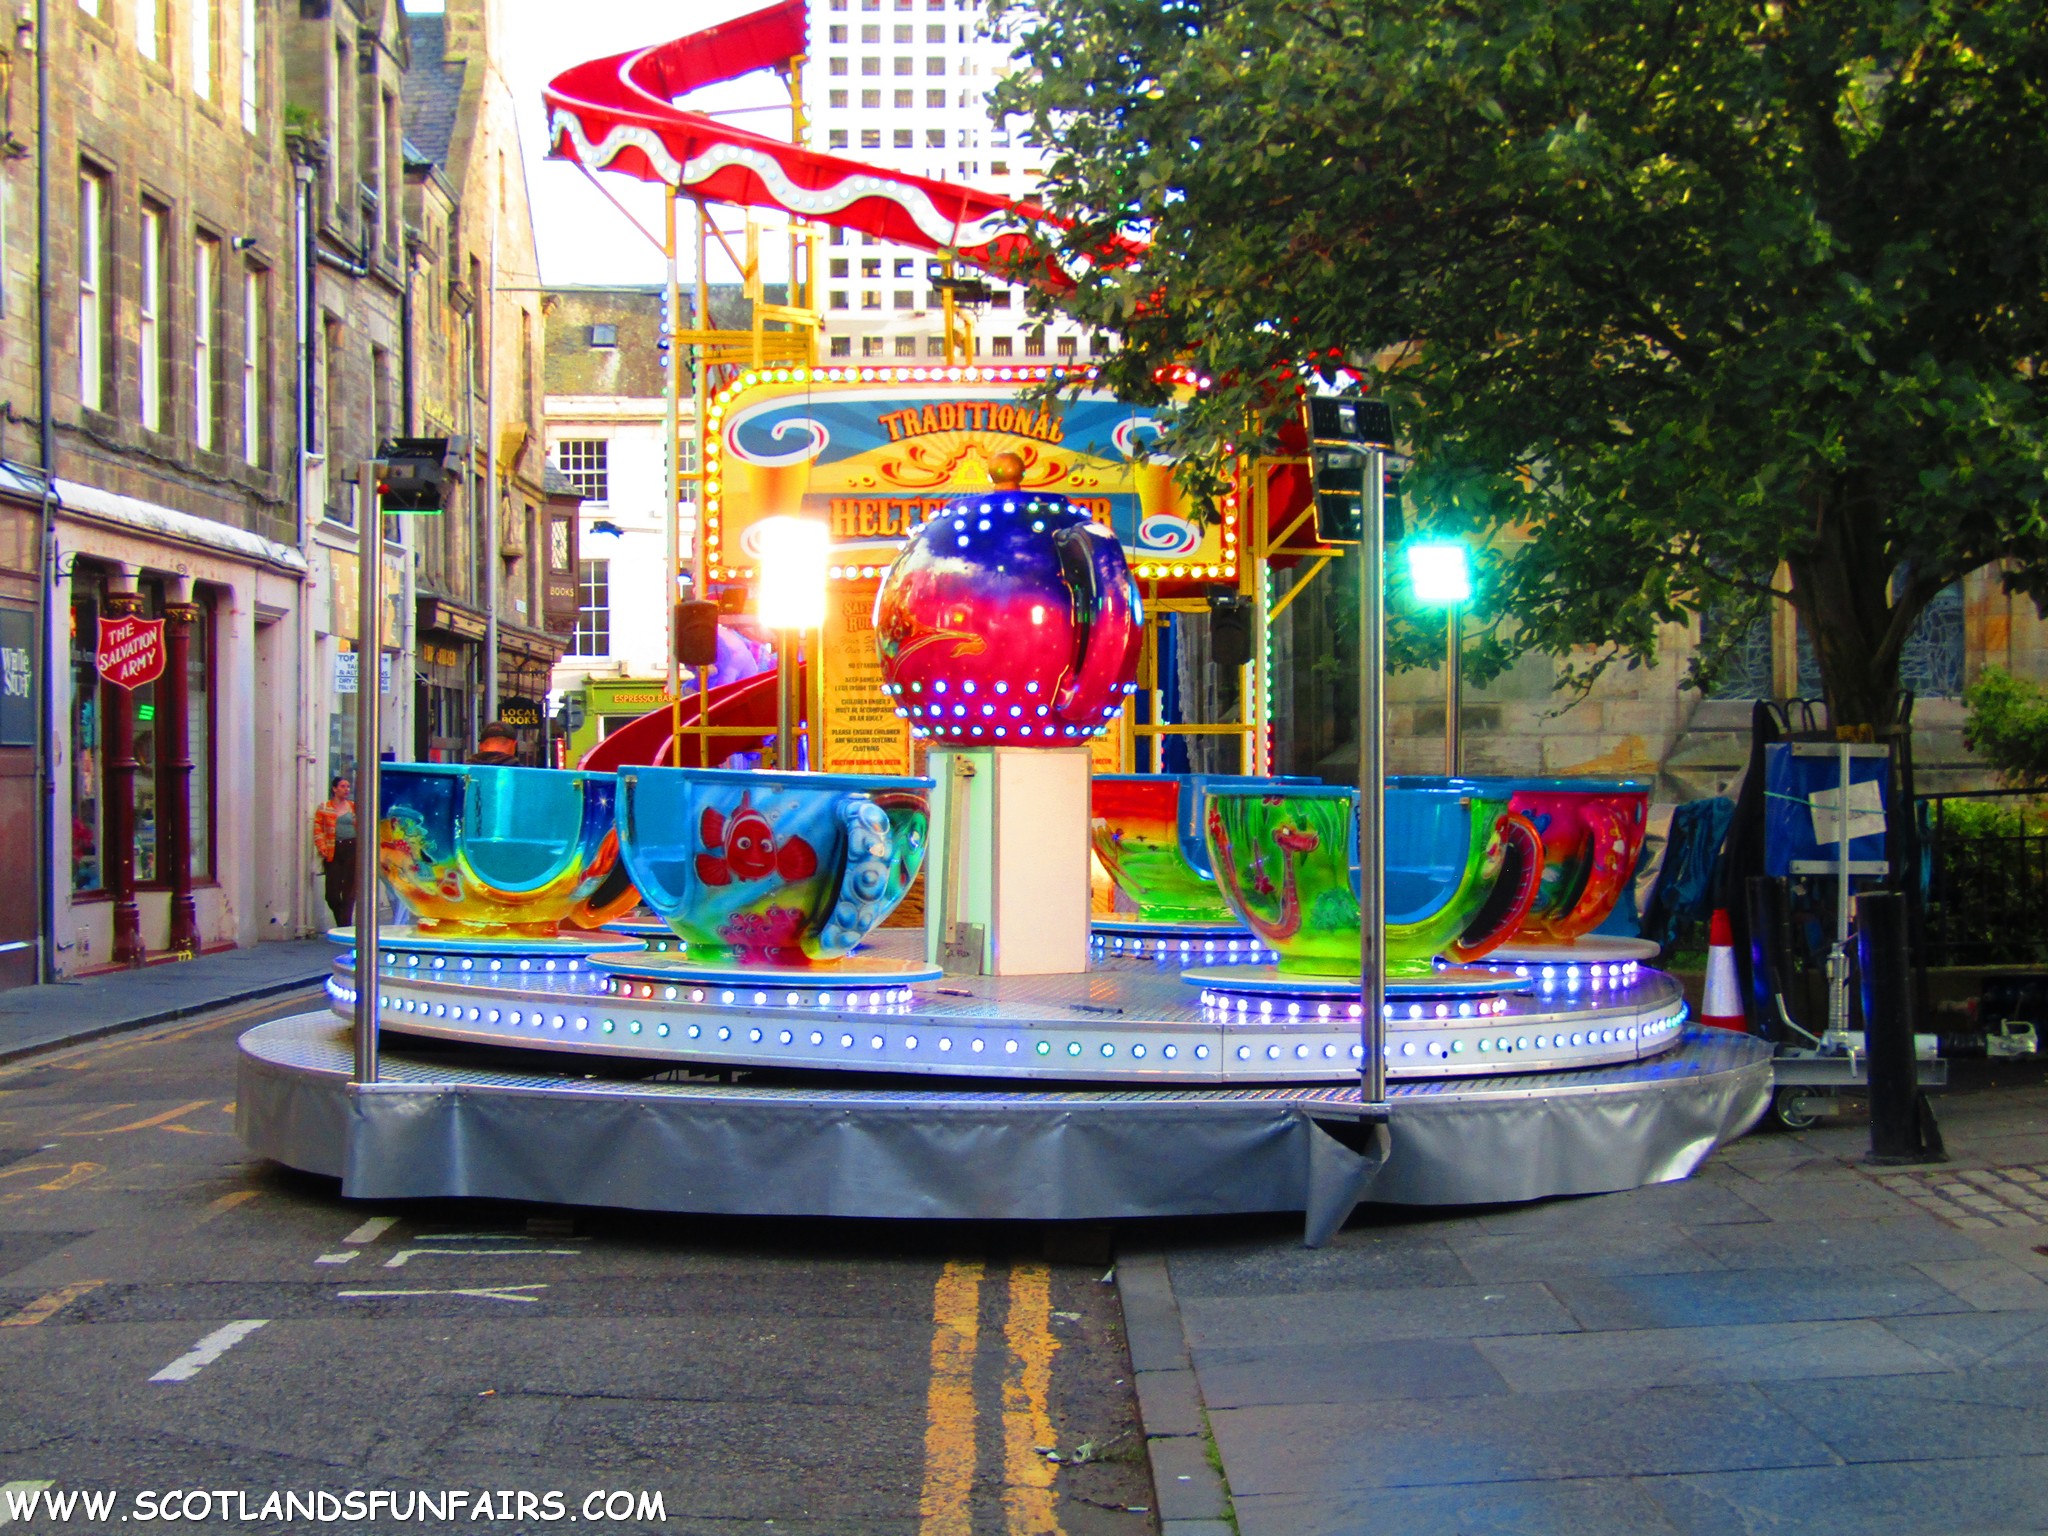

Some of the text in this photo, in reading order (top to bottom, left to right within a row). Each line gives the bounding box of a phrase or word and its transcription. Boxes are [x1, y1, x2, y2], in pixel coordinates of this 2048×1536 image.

[878, 400, 1065, 443] TRADITIONAL
[828, 497, 953, 538] HELTE
[550, 586, 575, 598] BOOKS
[842, 599, 873, 617] SAFE
[847, 616, 875, 632] RUL
[108, 622, 136, 647] THE
[99, 625, 158, 672] SALVATION
[120, 647, 157, 681] ARMY
[338, 654, 355, 662] TOP
[613, 694, 675, 704] ESPRESSO BAR
[501, 708, 538, 718] LOCAL
[501, 715, 539, 725] BOOKS
